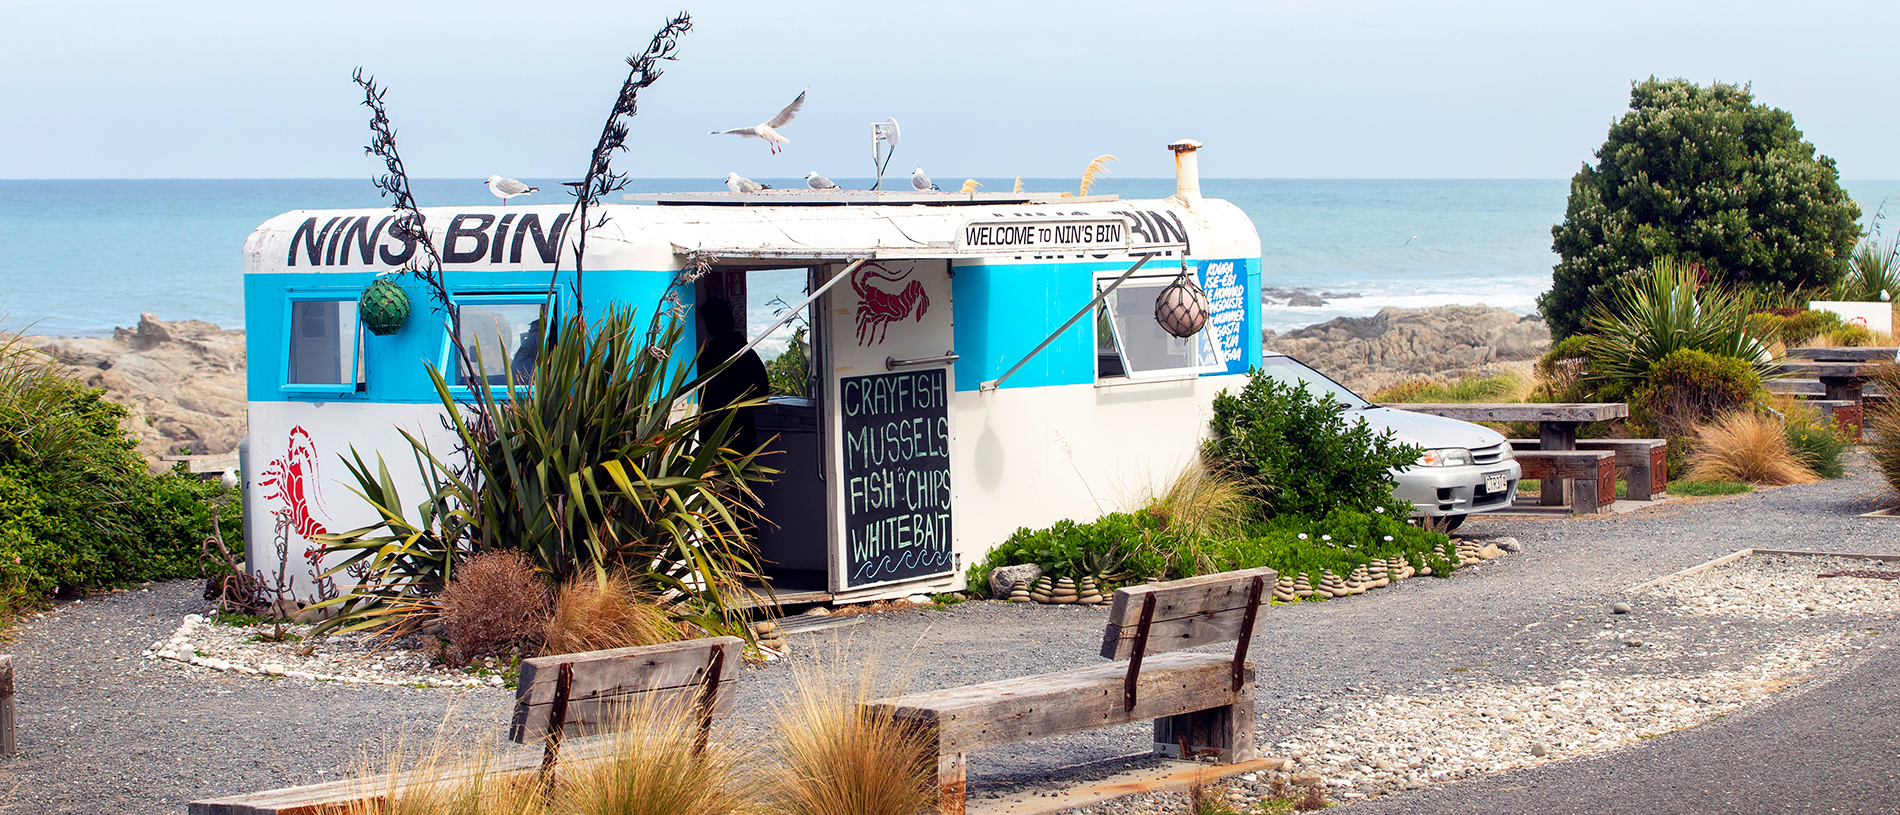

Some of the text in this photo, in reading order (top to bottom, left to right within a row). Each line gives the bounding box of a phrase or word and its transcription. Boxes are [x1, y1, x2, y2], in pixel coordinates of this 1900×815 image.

[287, 213, 571, 267] NINS BIN
[965, 224, 1121, 246] WELCOME TO NIN'S BIN
[1204, 273, 1237, 289] ISE-EBI
[1206, 261, 1234, 277] KOURA
[1213, 284, 1245, 301] HOMARD
[844, 373, 944, 417] CRAYFISH
[847, 416, 950, 471] MUSSELS
[850, 468, 896, 515] FISH
[906, 469, 952, 511] CHIPS
[852, 511, 950, 563] WHITEBAIT
